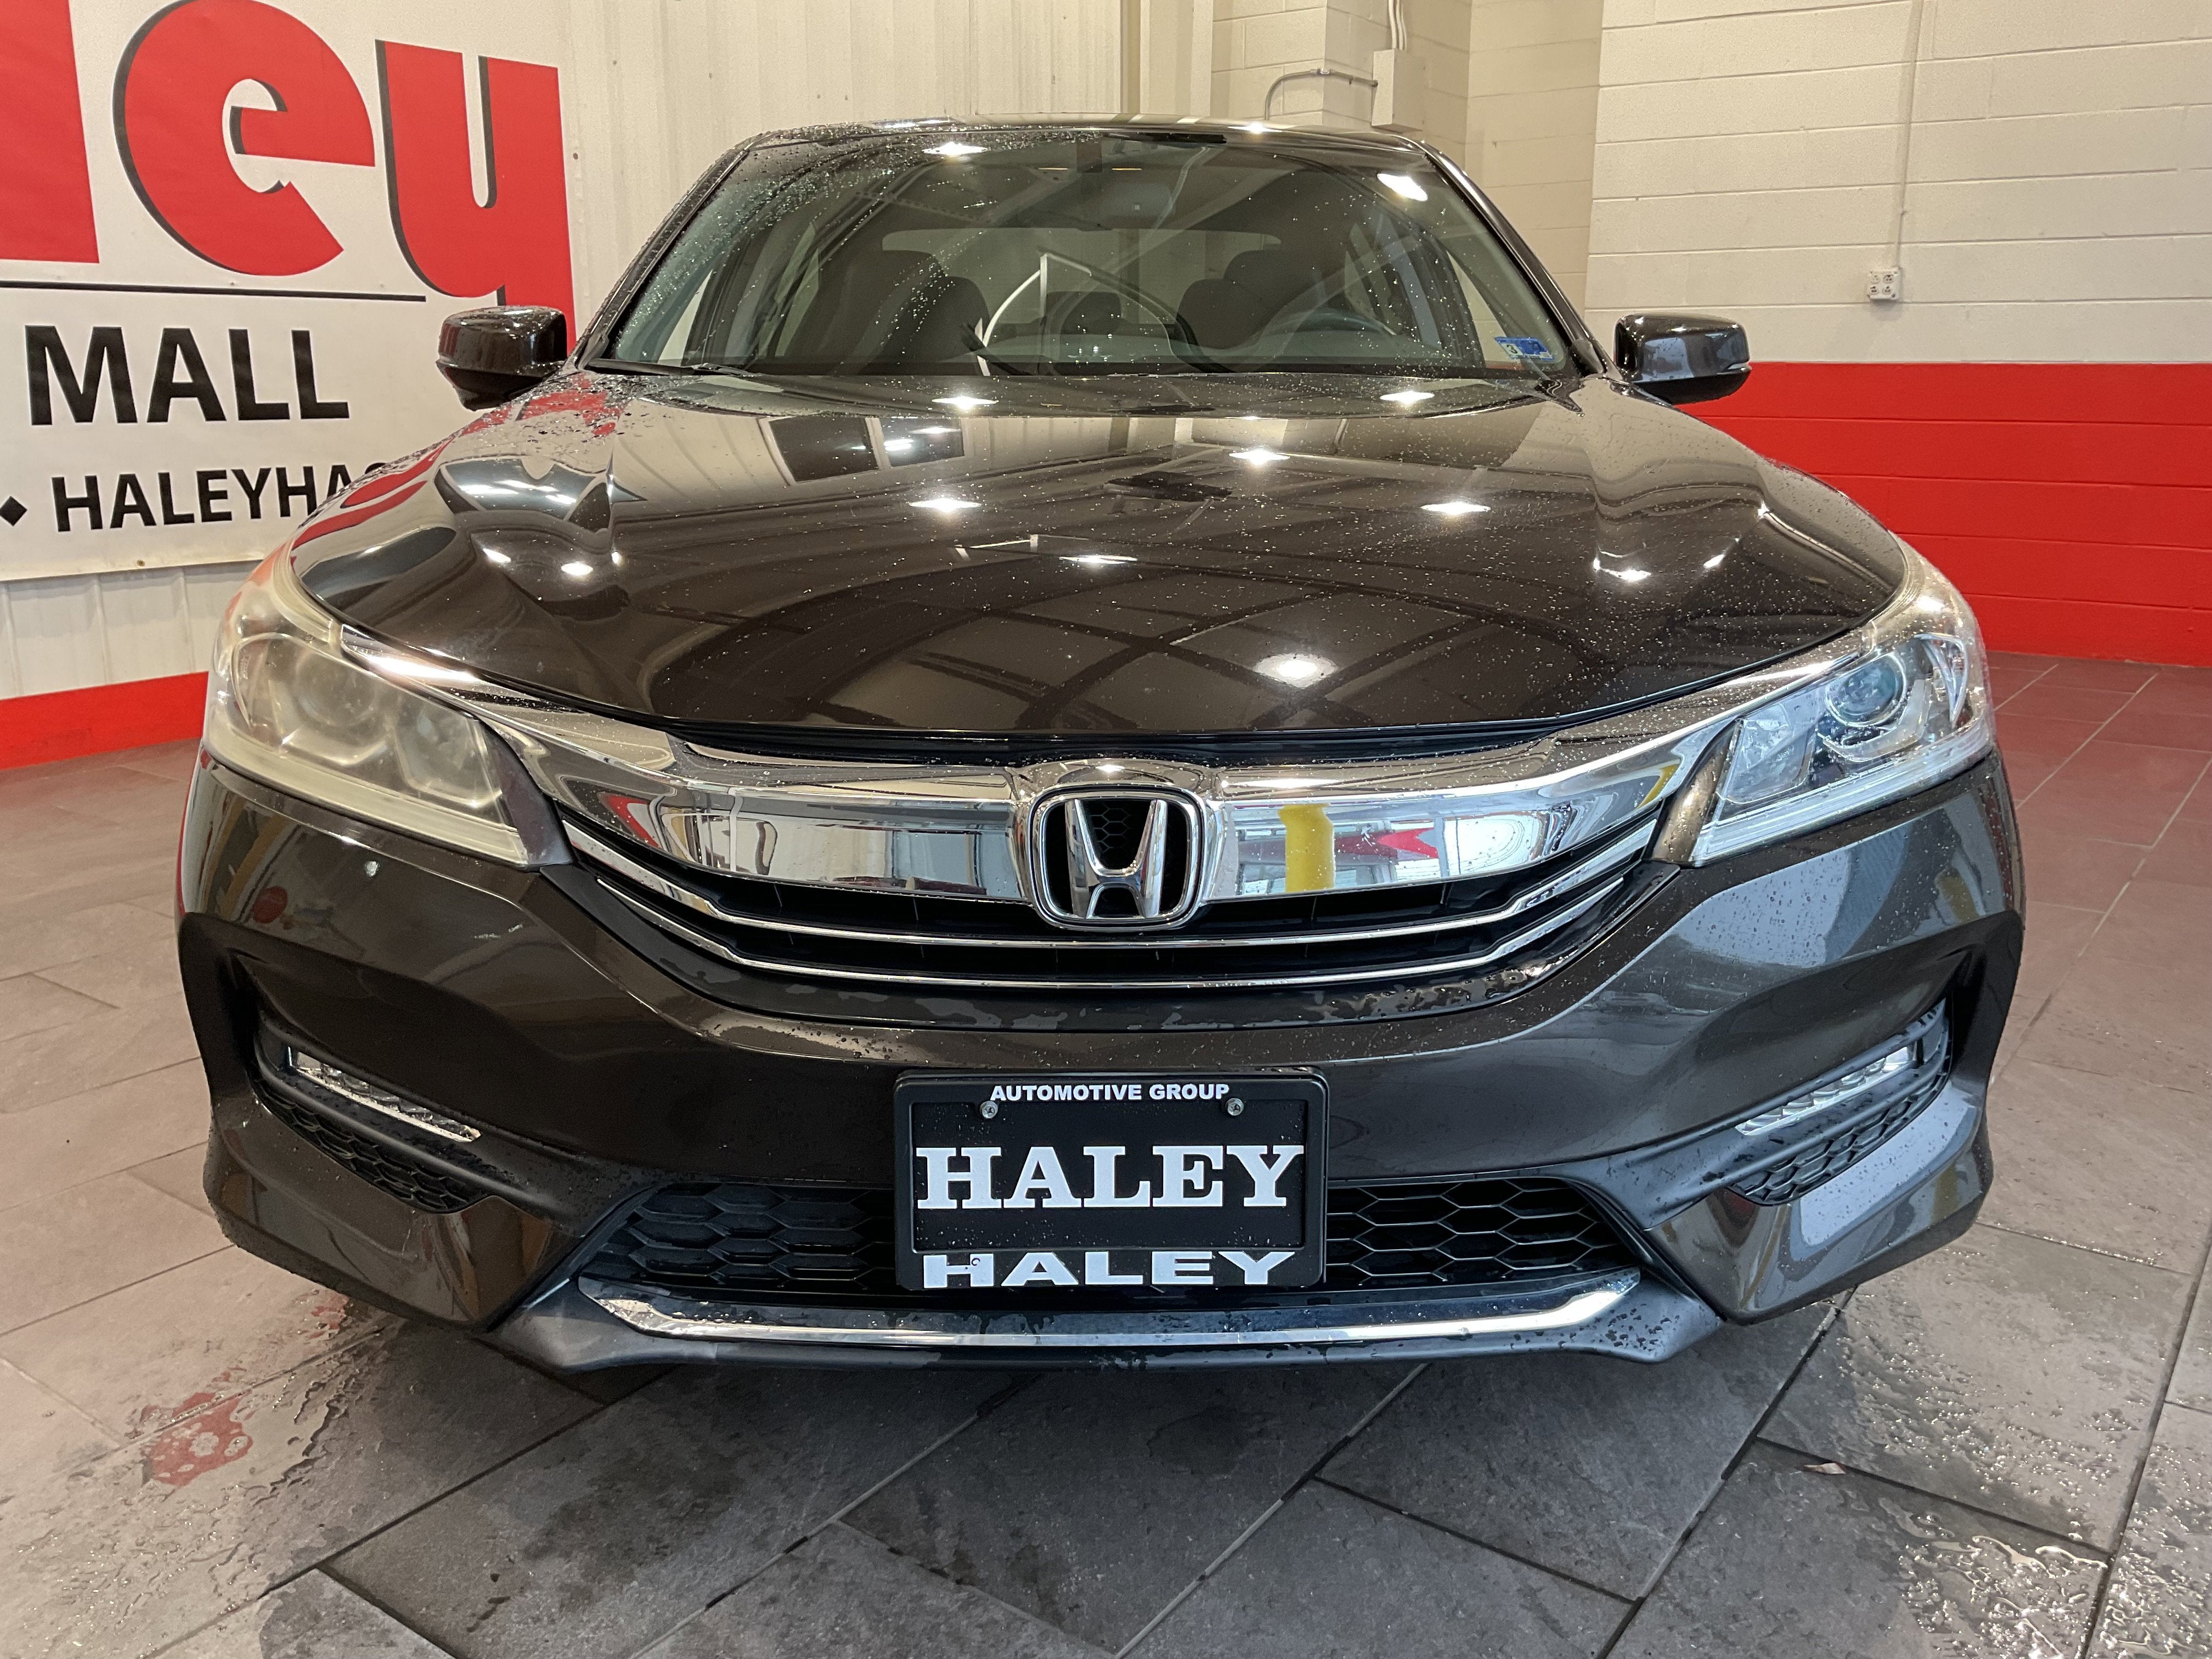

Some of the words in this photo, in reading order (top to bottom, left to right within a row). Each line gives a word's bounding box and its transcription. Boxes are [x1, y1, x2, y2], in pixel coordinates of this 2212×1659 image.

[25, 325, 350, 426] MALL
[52, 462, 386, 533] HALEYHA
[990, 1084, 1142, 1101] AUTOMOTIVE
[1149, 1083, 1230, 1100] GROUP
[916, 1144, 1305, 1210] HALEY
[923, 1250, 1296, 1289] HALEY
